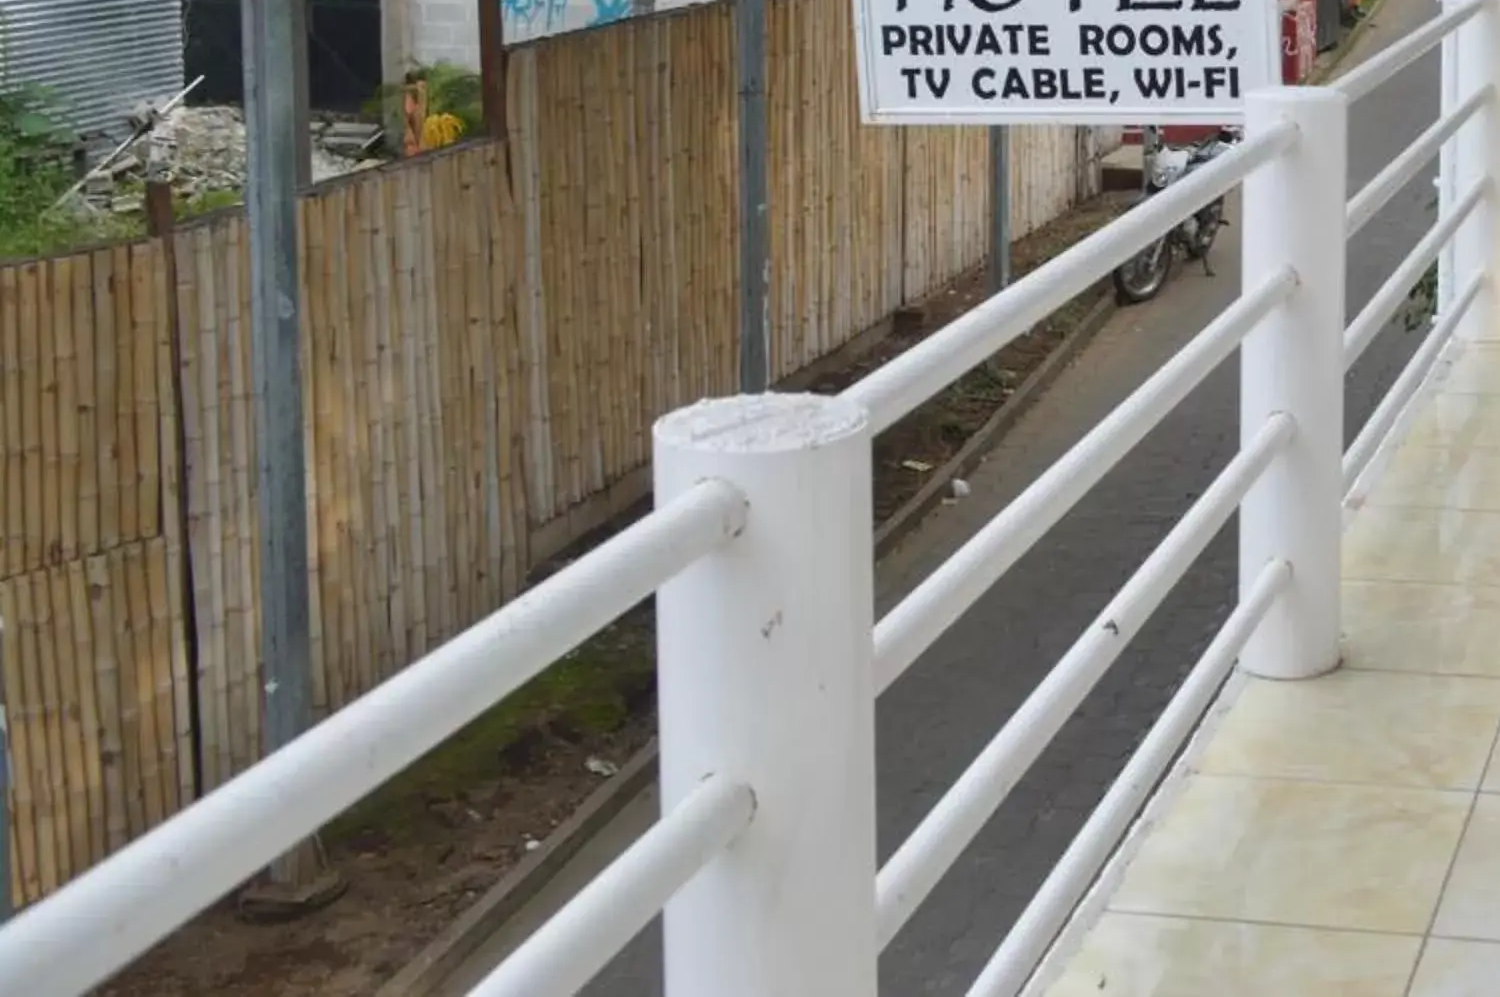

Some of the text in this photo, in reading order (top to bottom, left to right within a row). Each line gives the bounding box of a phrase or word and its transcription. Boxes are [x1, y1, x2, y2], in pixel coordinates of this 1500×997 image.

[881, 23, 1238, 61] PRIVATE ROOMS,
[900, 66, 1240, 105] TV CABLE, WI-FI
